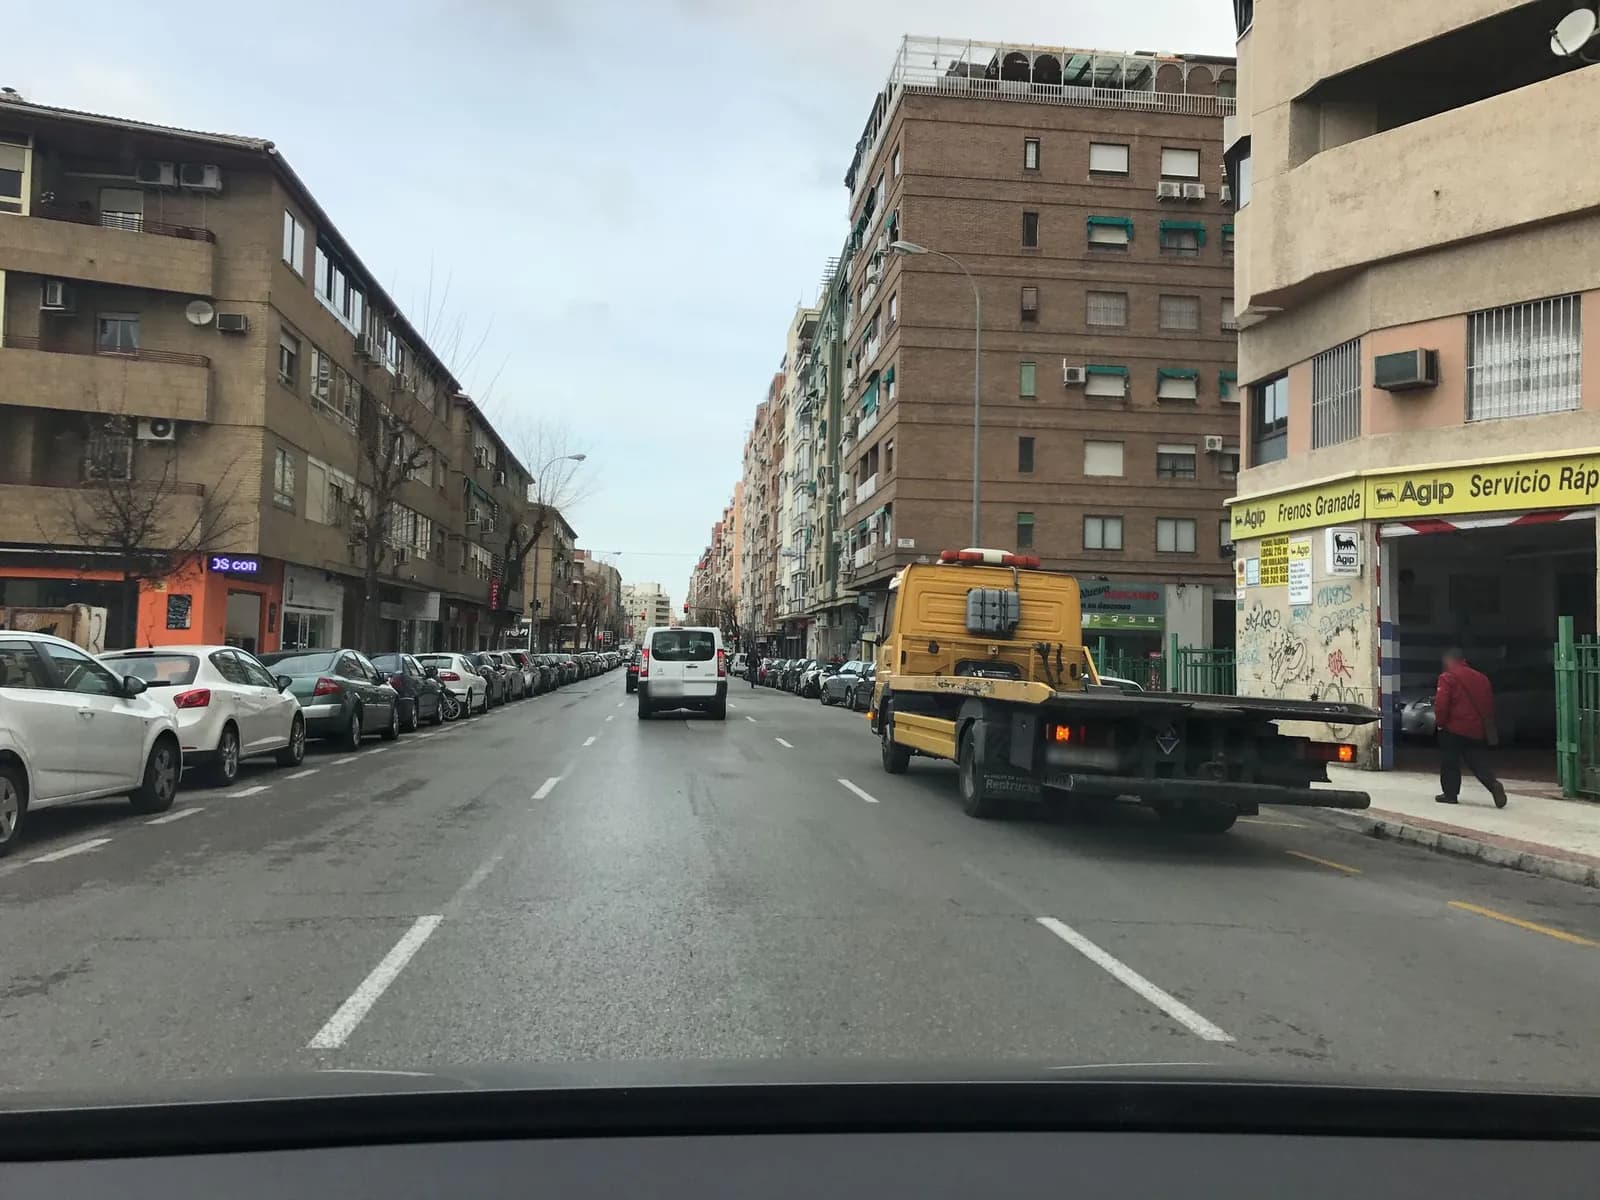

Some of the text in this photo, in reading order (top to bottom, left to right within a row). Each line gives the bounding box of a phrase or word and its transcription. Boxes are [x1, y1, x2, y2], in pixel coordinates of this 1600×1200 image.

[1400, 463, 1600, 506] Agip Servicio Ráp
[1244, 489, 1360, 529] Agip Frenos Granada
[232, 560, 257, 571] con
[1336, 554, 1355, 565] Agip
